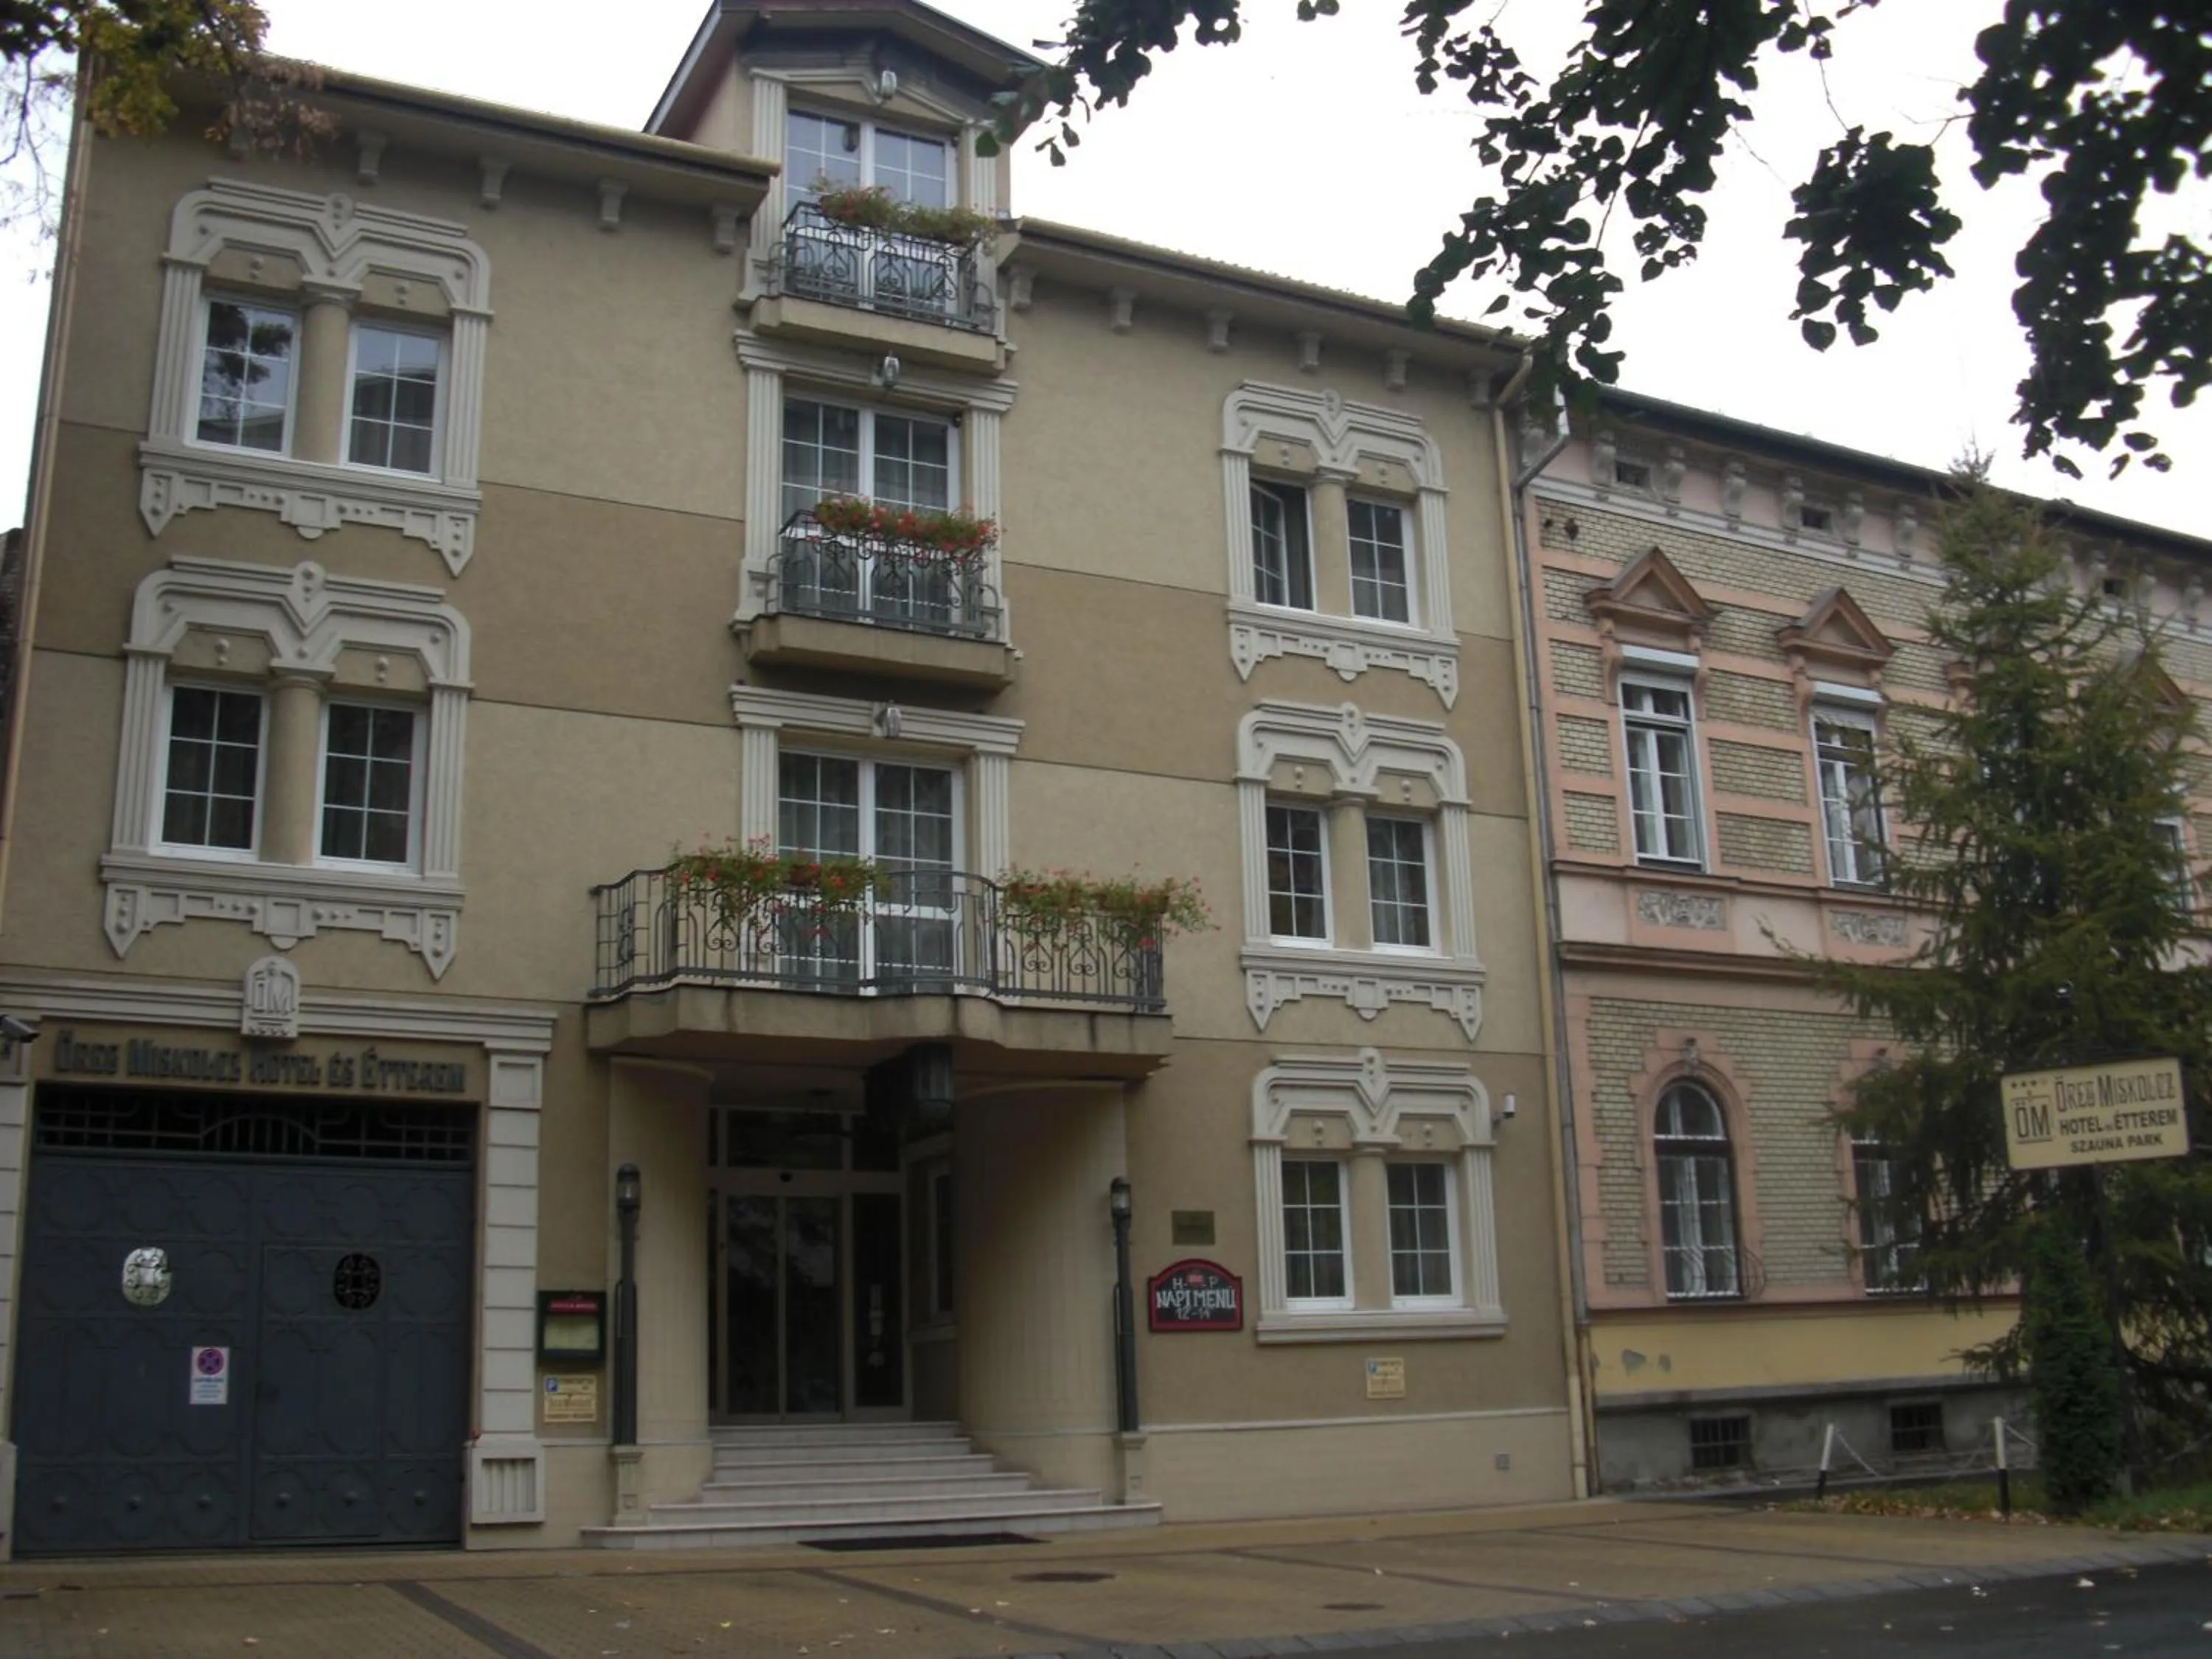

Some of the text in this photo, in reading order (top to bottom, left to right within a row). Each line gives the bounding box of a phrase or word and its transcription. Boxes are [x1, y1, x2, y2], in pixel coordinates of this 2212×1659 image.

[2059, 1108, 2179, 1136] HOTEL ÉTTEREM
[2070, 1133, 2164, 1154] SZAUNA PARK
